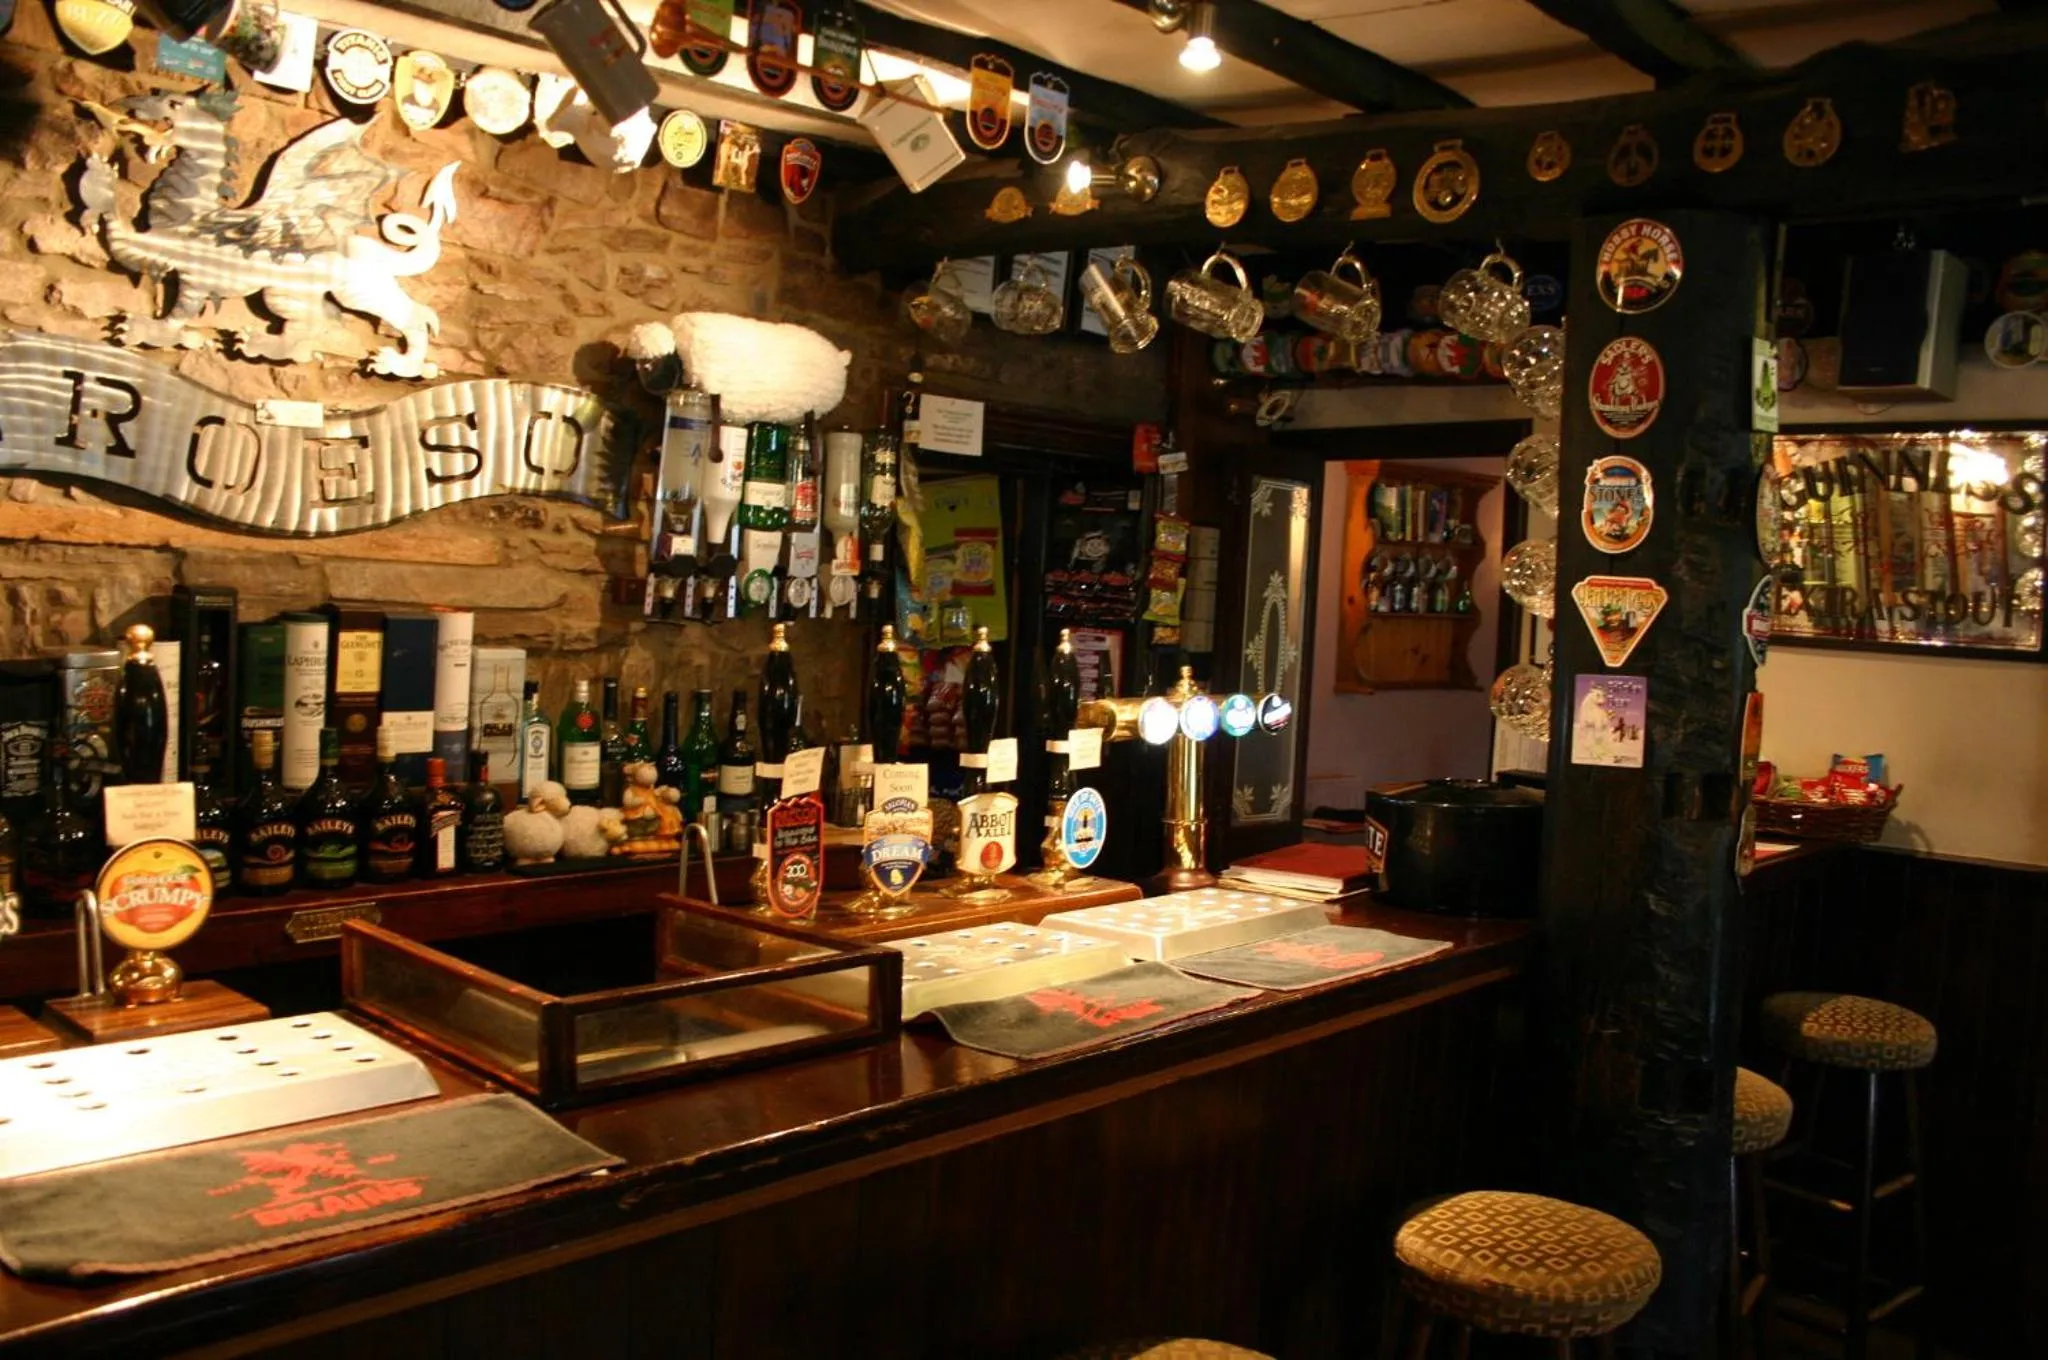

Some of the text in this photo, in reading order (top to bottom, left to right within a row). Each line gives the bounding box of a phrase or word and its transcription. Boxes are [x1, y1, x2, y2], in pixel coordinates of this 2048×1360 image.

[1602, 224, 1678, 262] HOBBY HORSE
[0, 369, 586, 506] ROESO
[1778, 446, 2042, 515] GUINNSS
[965, 810, 1014, 838] ABBOT
[982, 828, 1006, 838] ALE
[871, 847, 924, 863] DREAM
[99, 887, 206, 918] SCRUMPY
